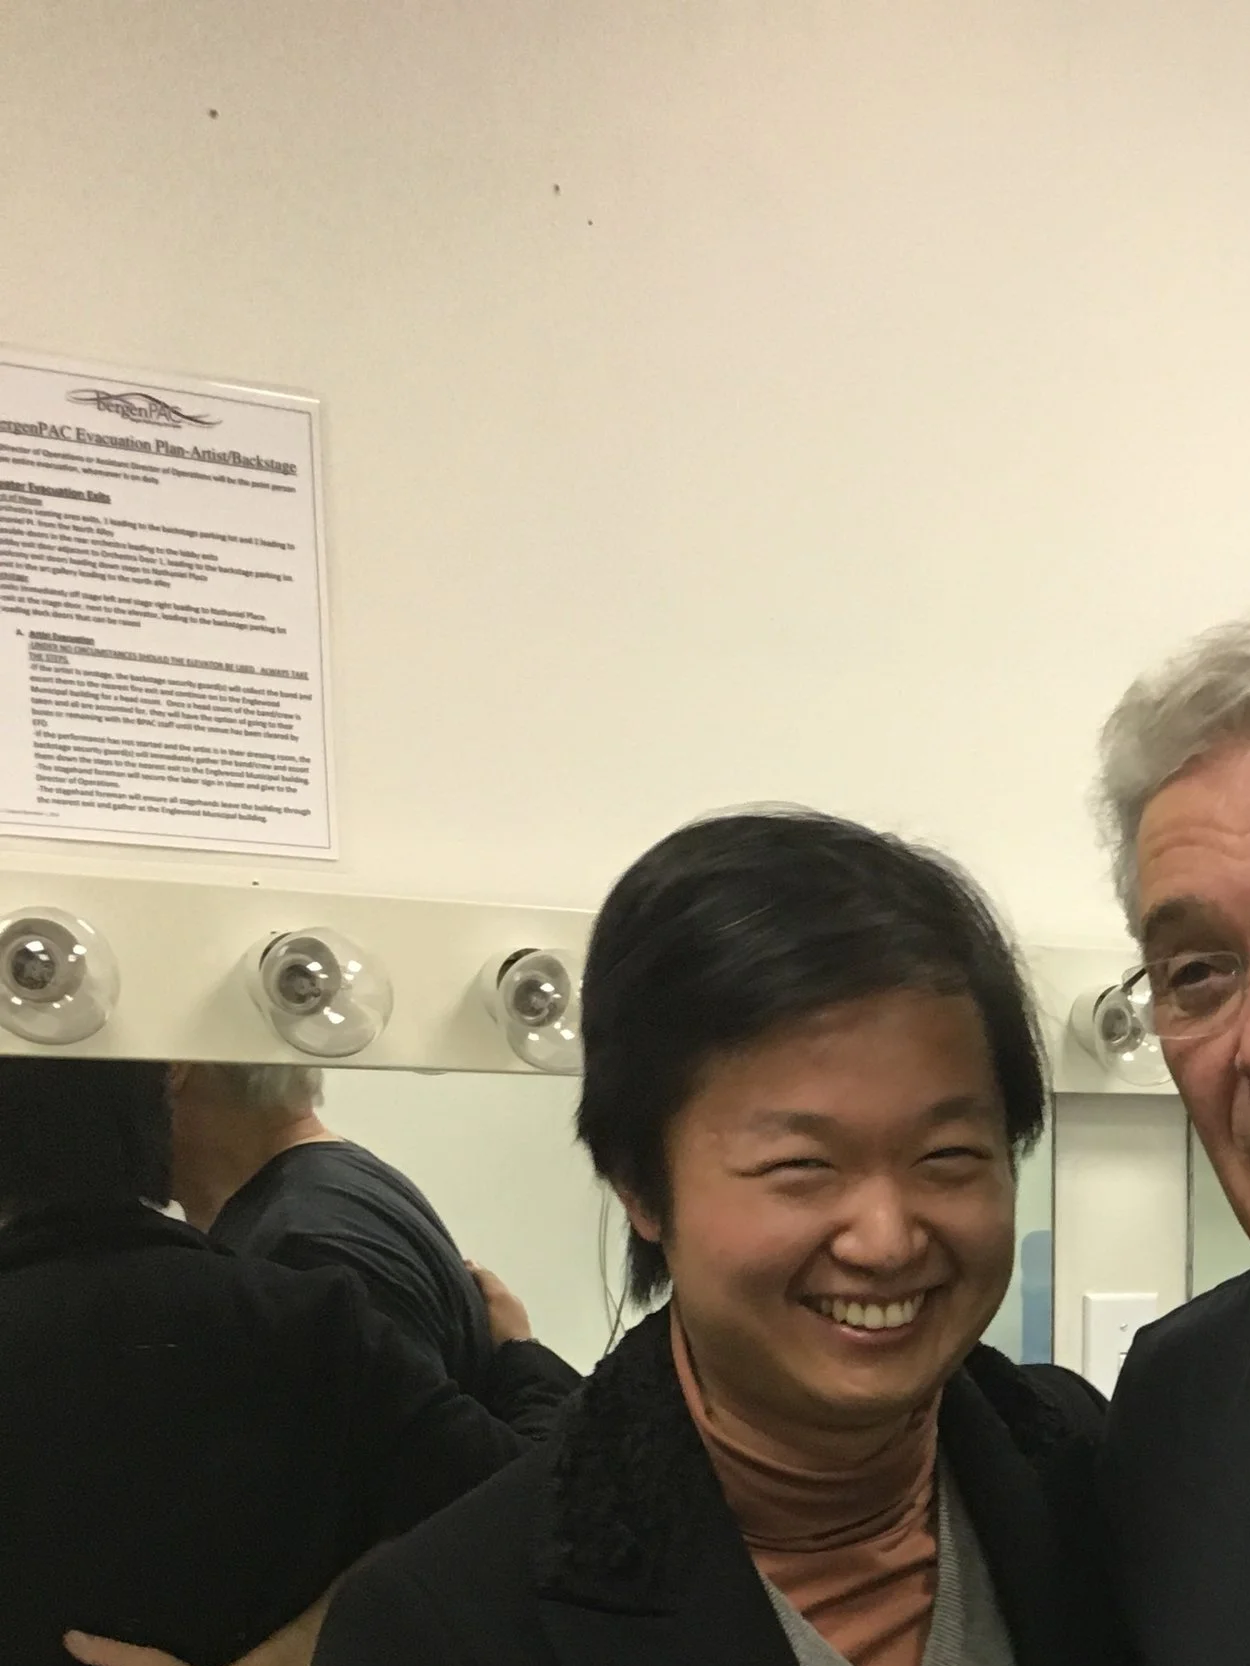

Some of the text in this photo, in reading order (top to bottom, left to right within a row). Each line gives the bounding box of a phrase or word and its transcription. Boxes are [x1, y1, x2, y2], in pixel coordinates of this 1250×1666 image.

[96, 391, 182, 424] bergenPAC
[0, 420, 296, 476] ergenPAC Evacuation Plan-Artist/Backstage
